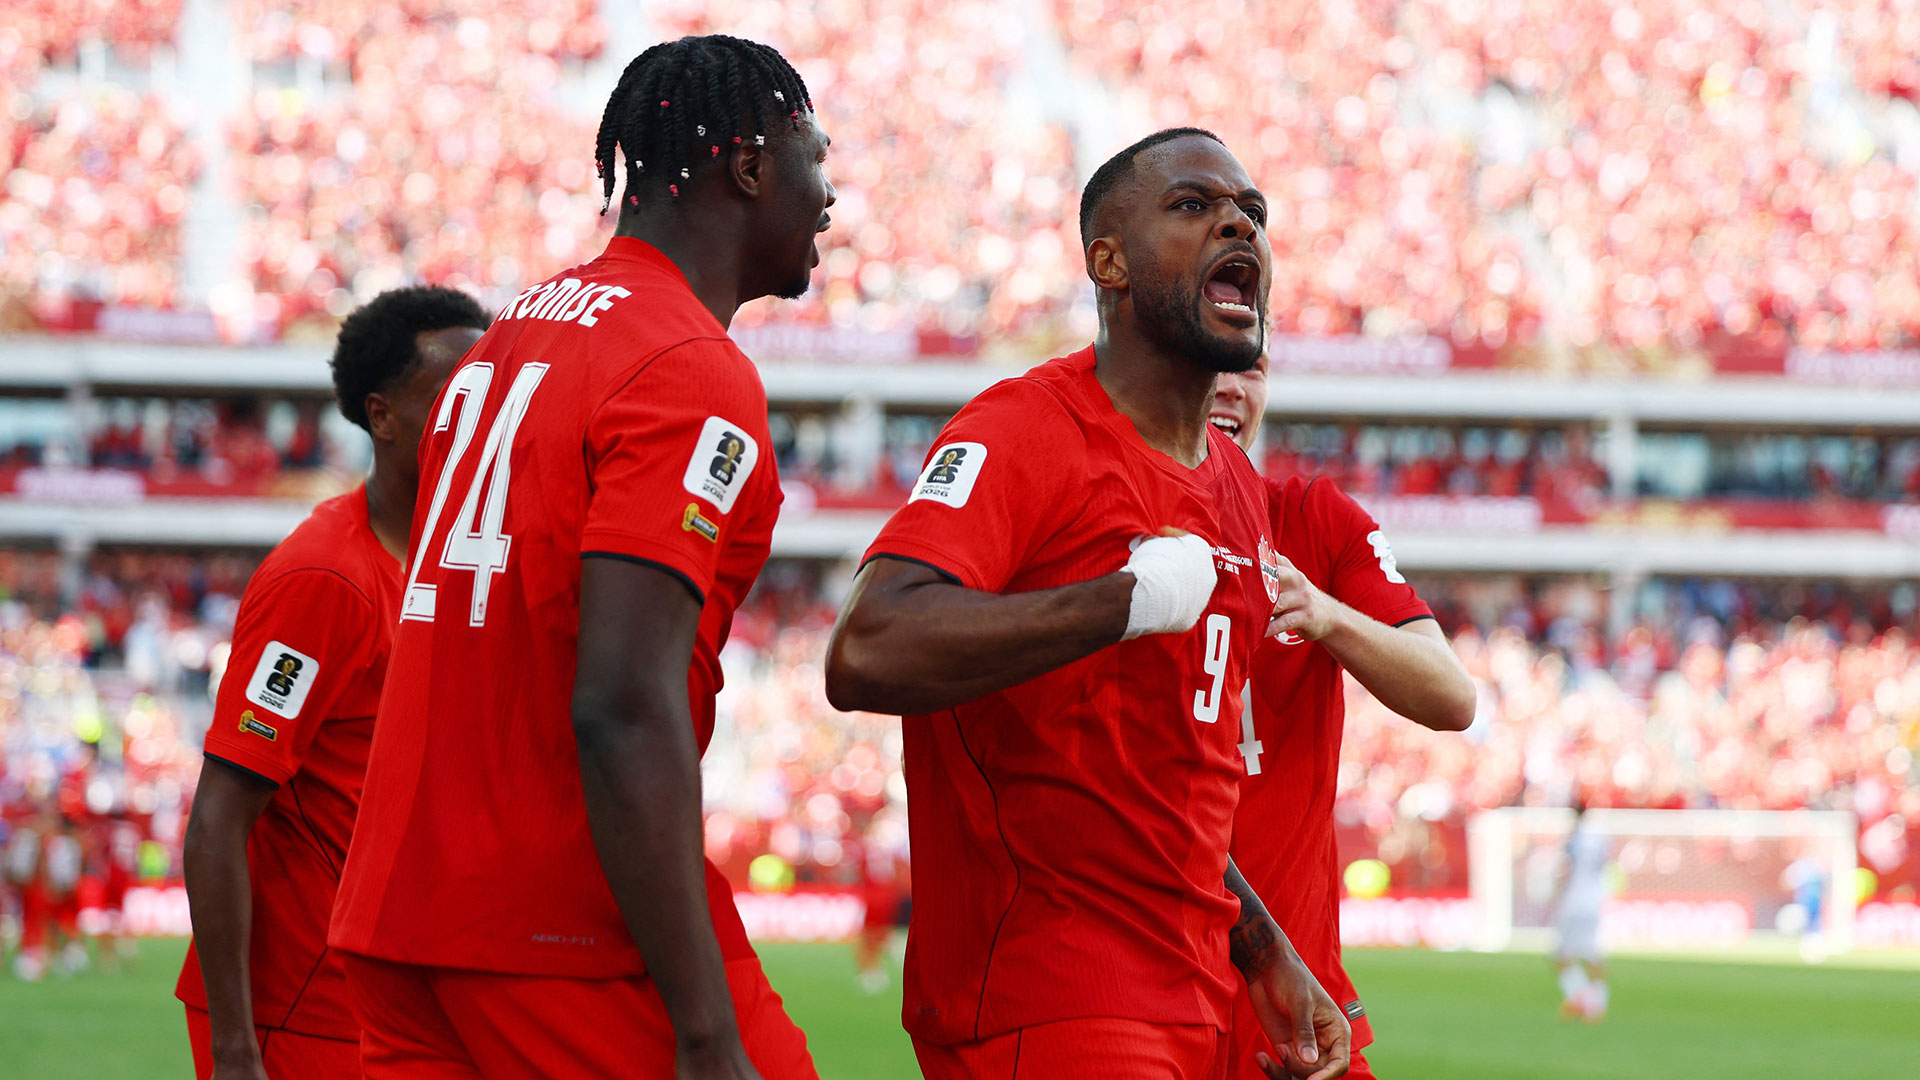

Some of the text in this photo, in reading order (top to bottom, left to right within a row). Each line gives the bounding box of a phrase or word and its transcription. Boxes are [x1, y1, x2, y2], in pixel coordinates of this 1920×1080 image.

[497, 278, 632, 328] ROMISE
[400, 361, 551, 627] 24
[919, 489, 948, 497] 2026
[1193, 613, 1231, 724] 9
